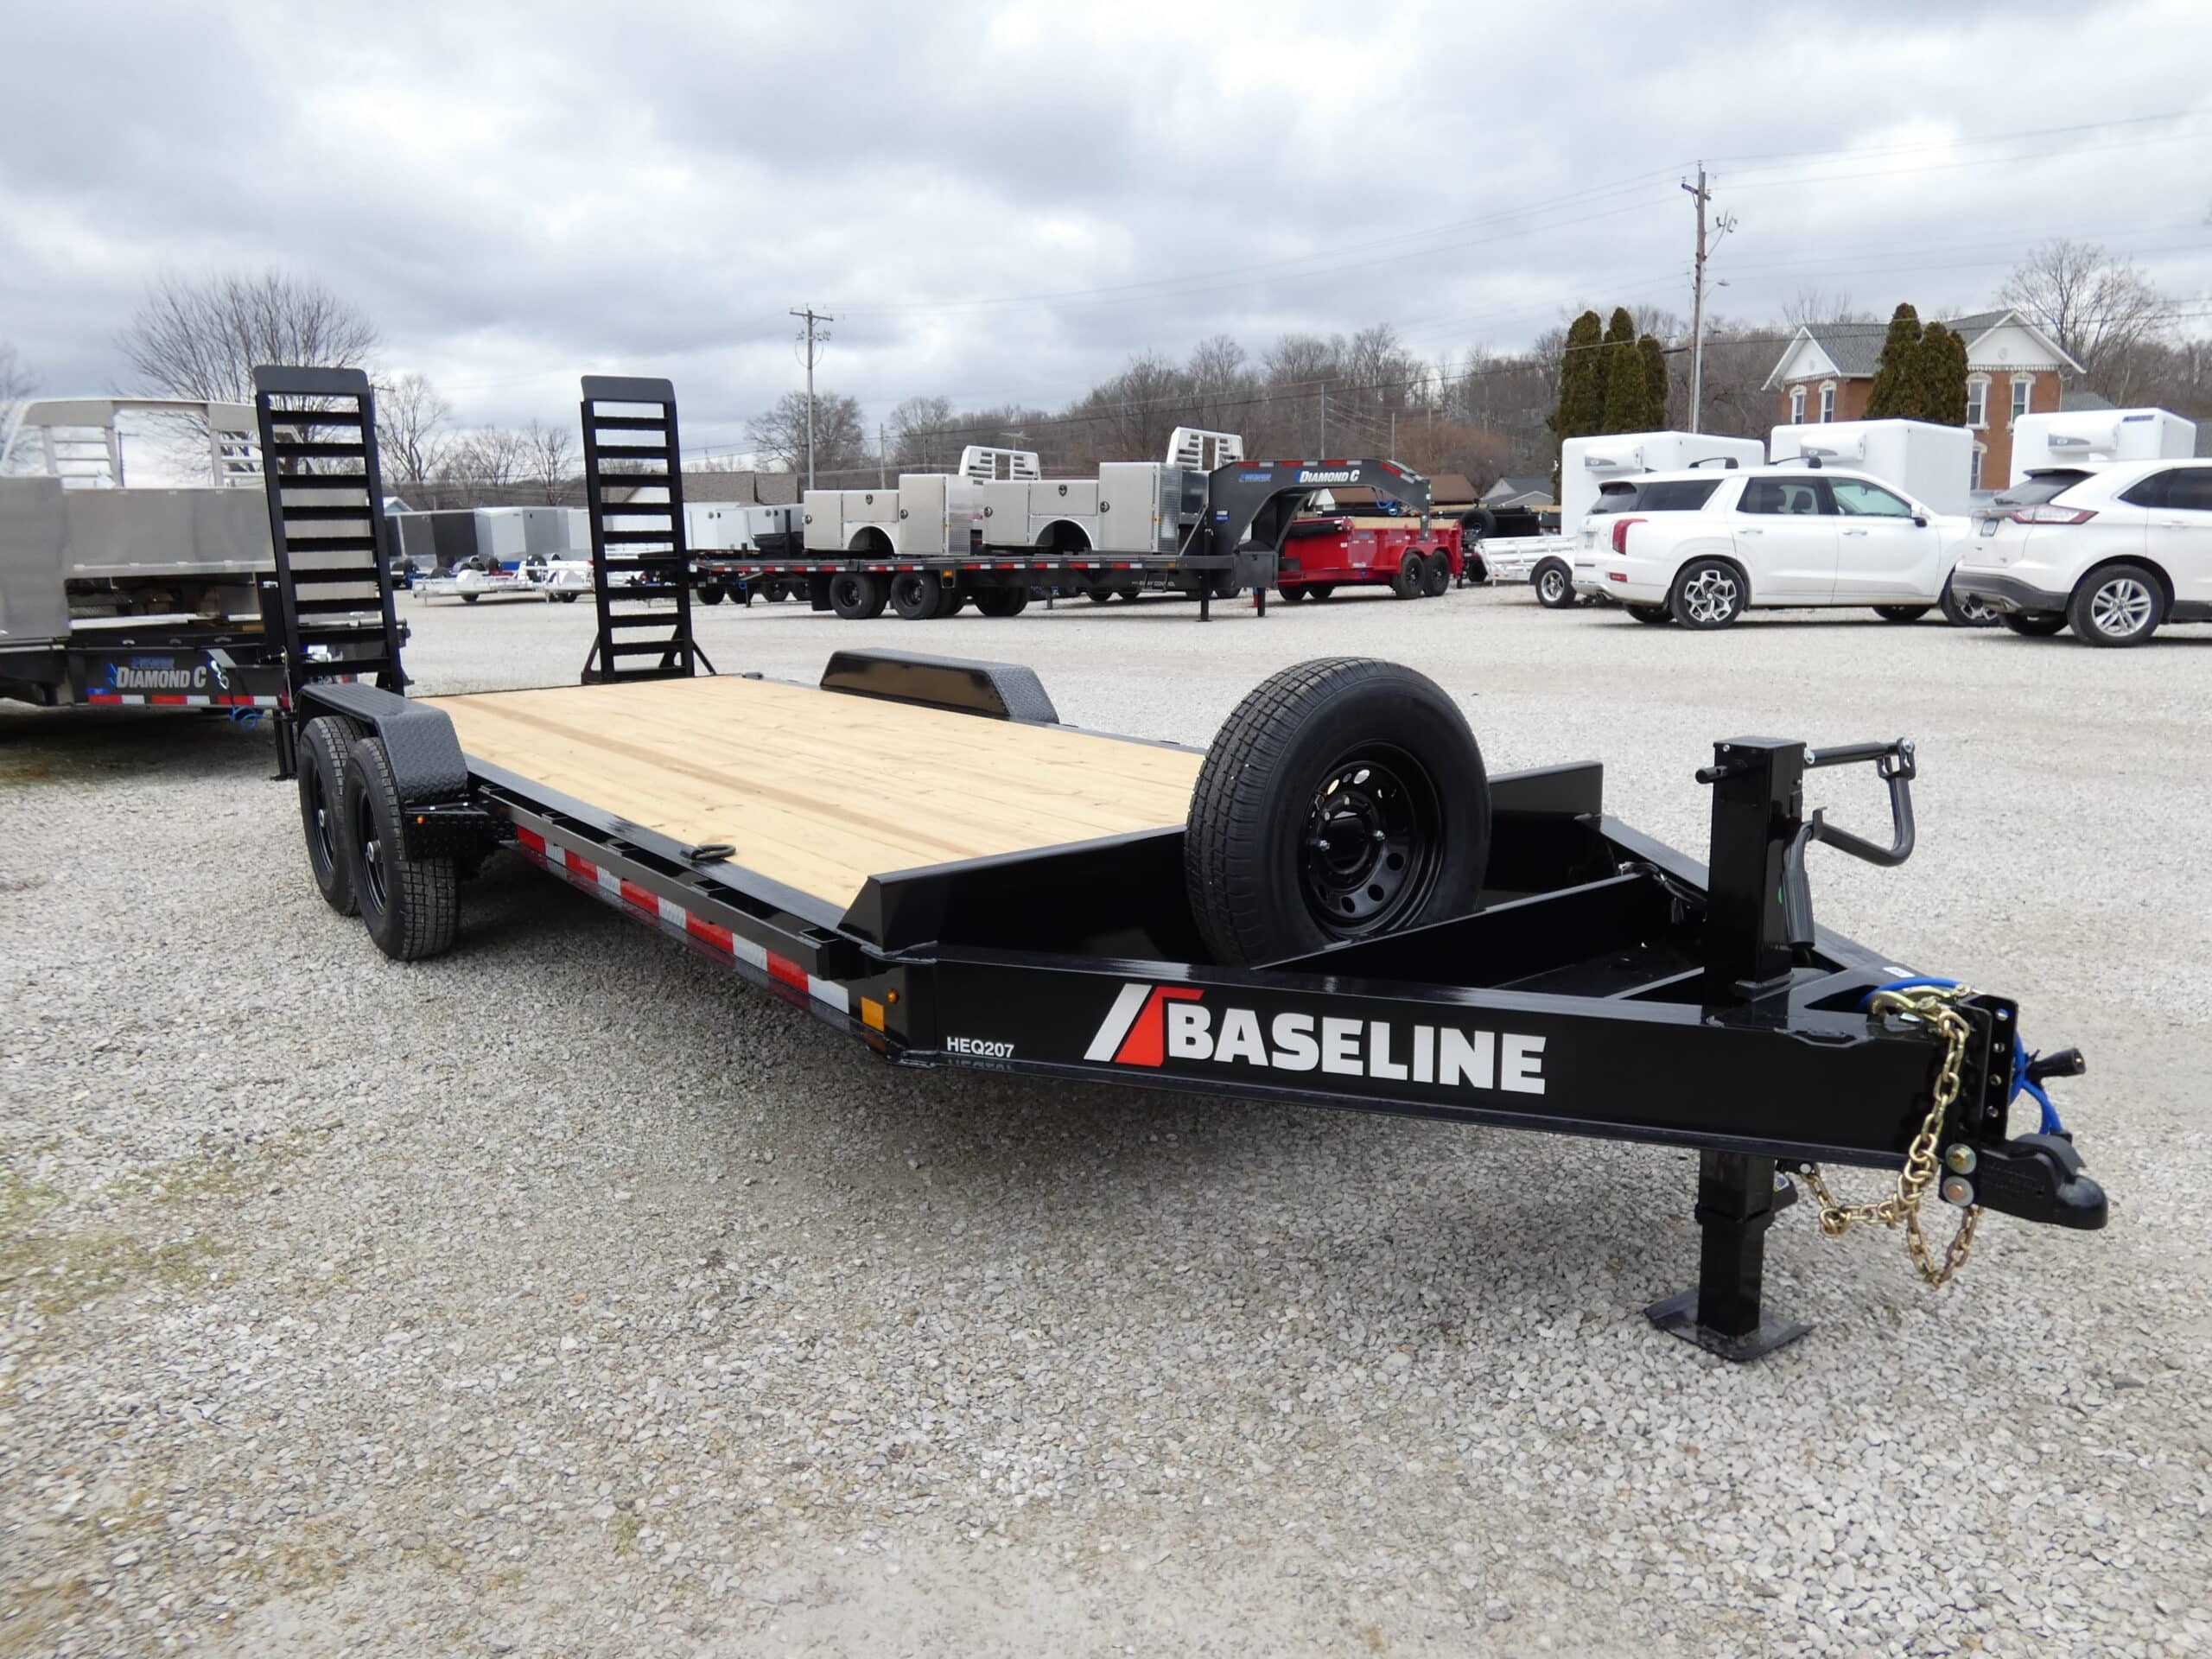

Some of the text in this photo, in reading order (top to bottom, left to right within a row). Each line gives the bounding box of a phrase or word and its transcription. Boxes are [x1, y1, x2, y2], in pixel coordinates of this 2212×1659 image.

[1300, 469, 1360, 483] DIAMOND C
[116, 665, 207, 689] DIAMOND C
[947, 1036, 1014, 1058] HEQ207
[1167, 1002, 1547, 1096] BASELINE
